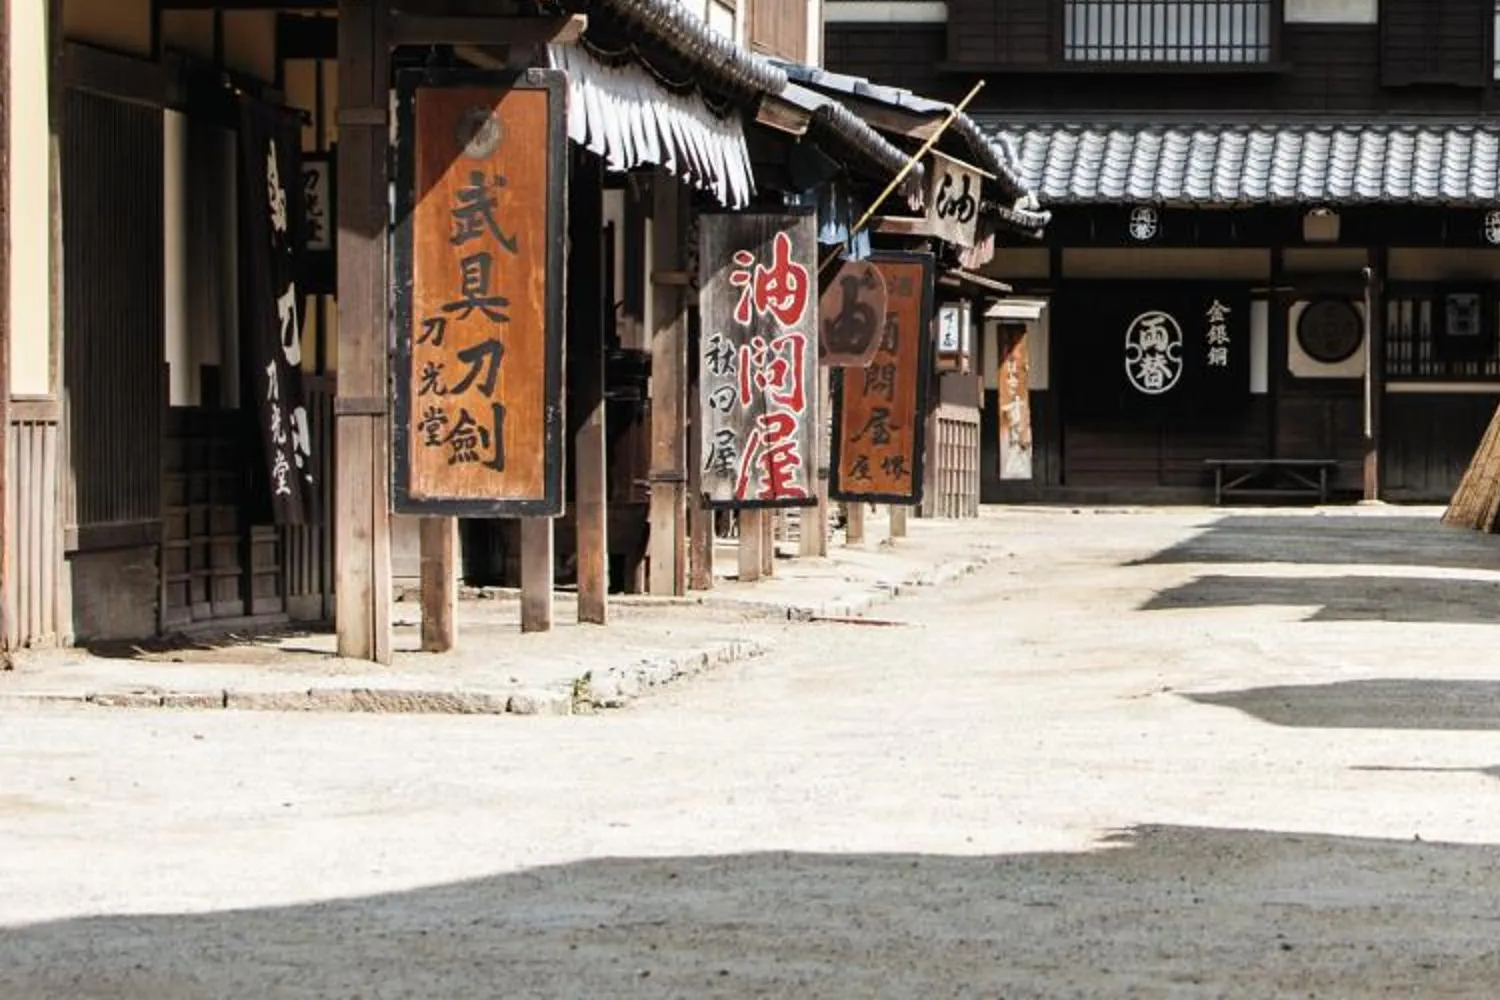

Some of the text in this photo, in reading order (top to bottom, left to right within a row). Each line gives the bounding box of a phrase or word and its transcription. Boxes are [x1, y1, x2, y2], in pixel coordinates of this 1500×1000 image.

[416, 316, 449, 447] 刀光堂
[729, 231, 809, 499] 油問屋
[1135, 315, 1174, 390] 両替
[1205, 299, 1232, 367] 金銀銅
